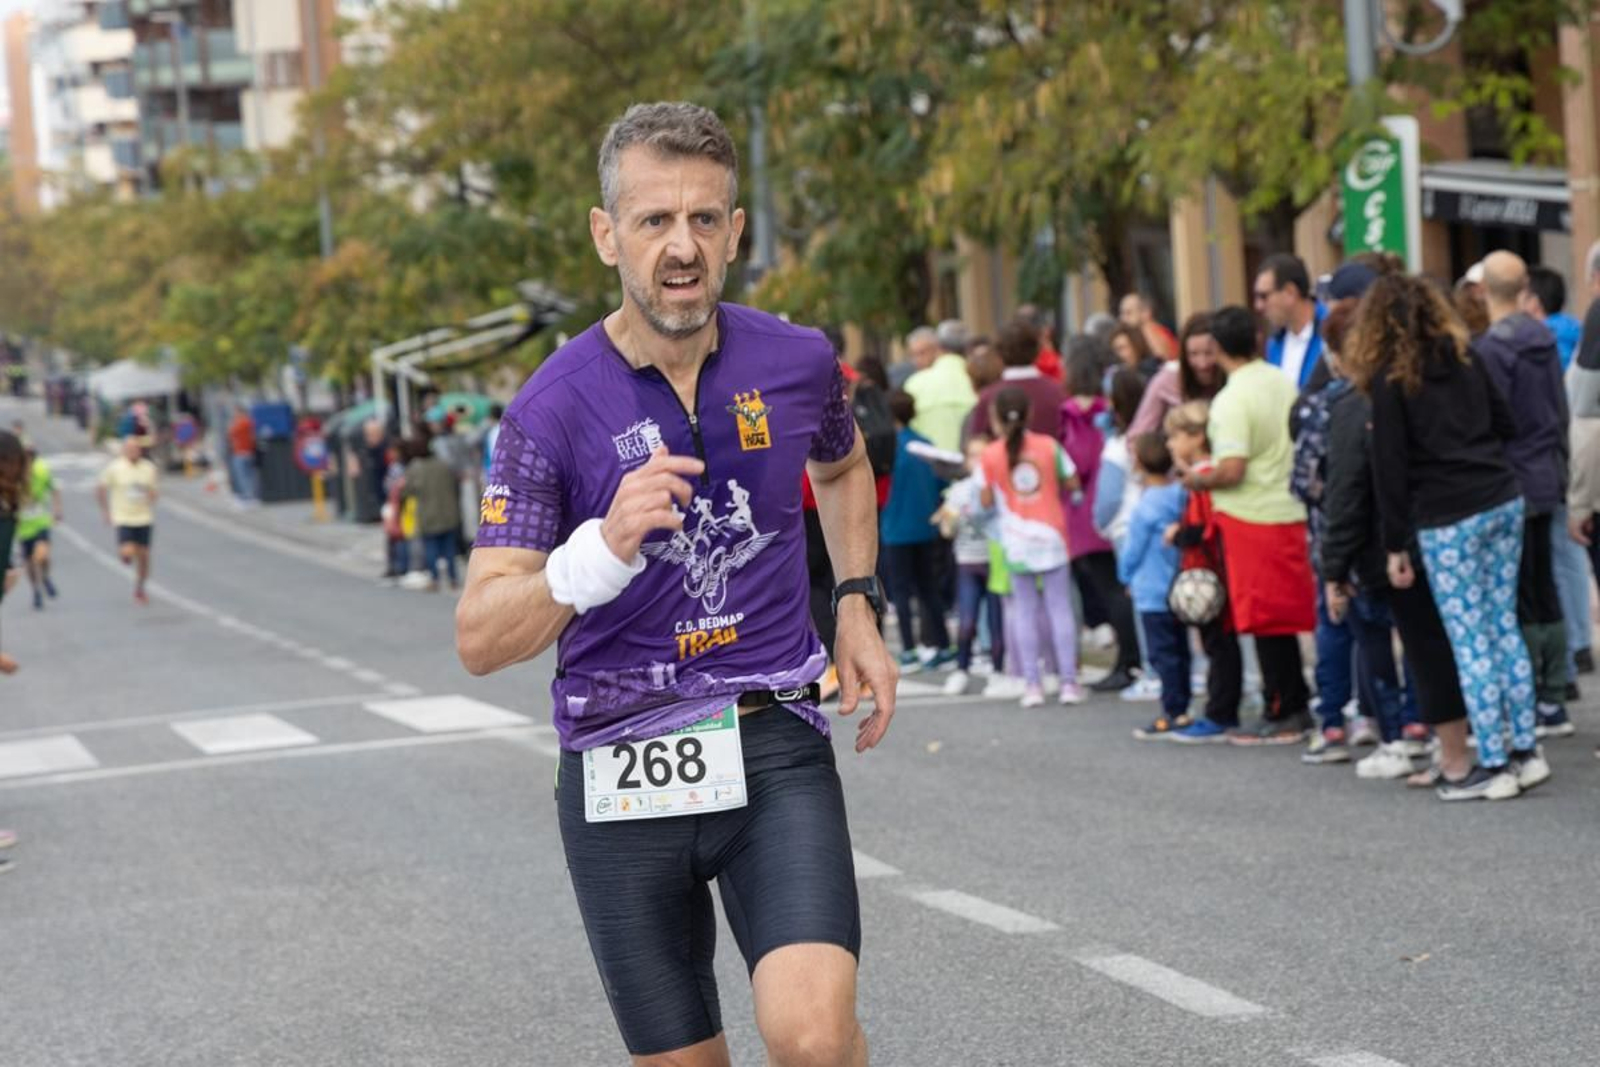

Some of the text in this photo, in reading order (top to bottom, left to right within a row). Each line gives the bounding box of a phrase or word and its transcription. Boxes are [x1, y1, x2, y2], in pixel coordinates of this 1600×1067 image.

[675, 612, 745, 633] C.D. BEDMAR
[674, 626, 738, 661] TRAIL
[612, 736, 707, 790] 268
